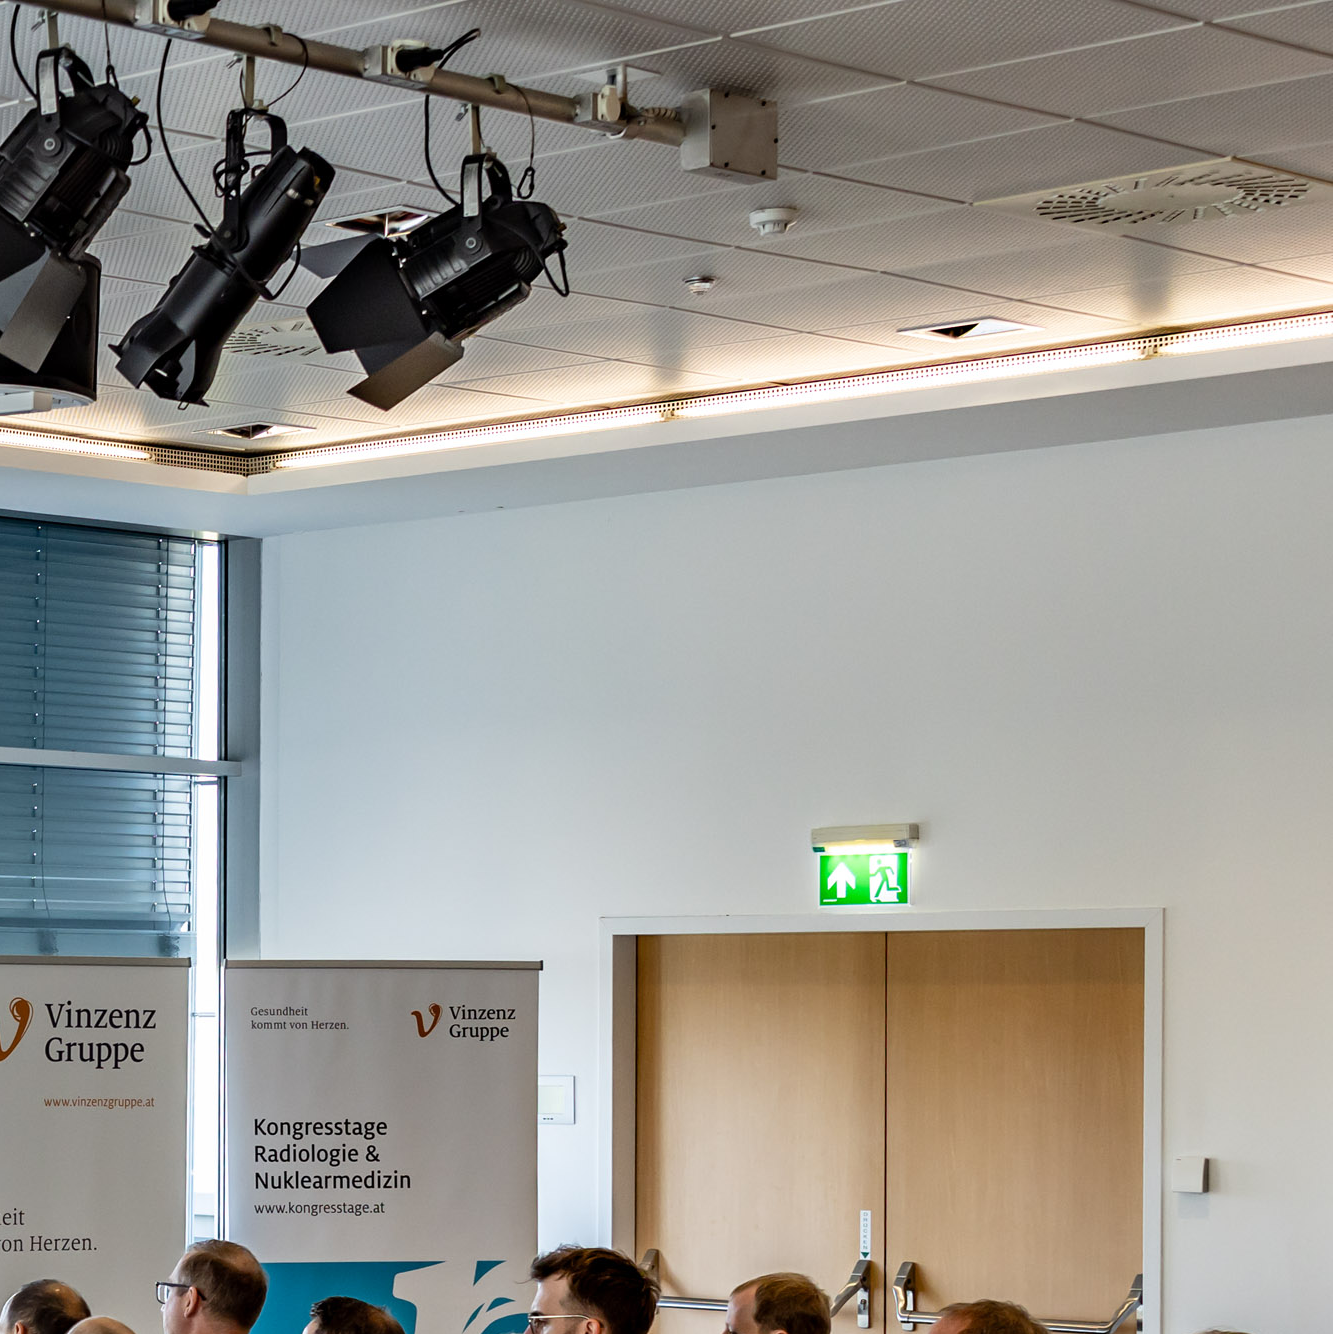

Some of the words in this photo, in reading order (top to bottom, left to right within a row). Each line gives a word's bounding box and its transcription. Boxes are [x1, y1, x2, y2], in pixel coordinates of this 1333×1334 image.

[44, 1000, 157, 1029] Vinzenz
[250, 1006, 309, 1017] Gesundheit
[448, 1004, 517, 1021] Vinzenz
[251, 1020, 287, 1030] kommt
[289, 1022, 308, 1030] von
[311, 1020, 350, 1030] Herzen.
[448, 1023, 510, 1042] Gruppe
[44, 1036, 146, 1070] Gruppe
[43, 1095, 155, 1110] www.vinzenzgruppe.at
[253, 1118, 389, 1141] Kongresstage
[254, 1143, 360, 1167] Radiologie
[365, 1144, 381, 1163] &
[254, 1169, 412, 1190] Nuklearmedizin
[253, 1201, 386, 1217] www.kongresstage.at
[29, 1235, 98, 1252] Herzen.
